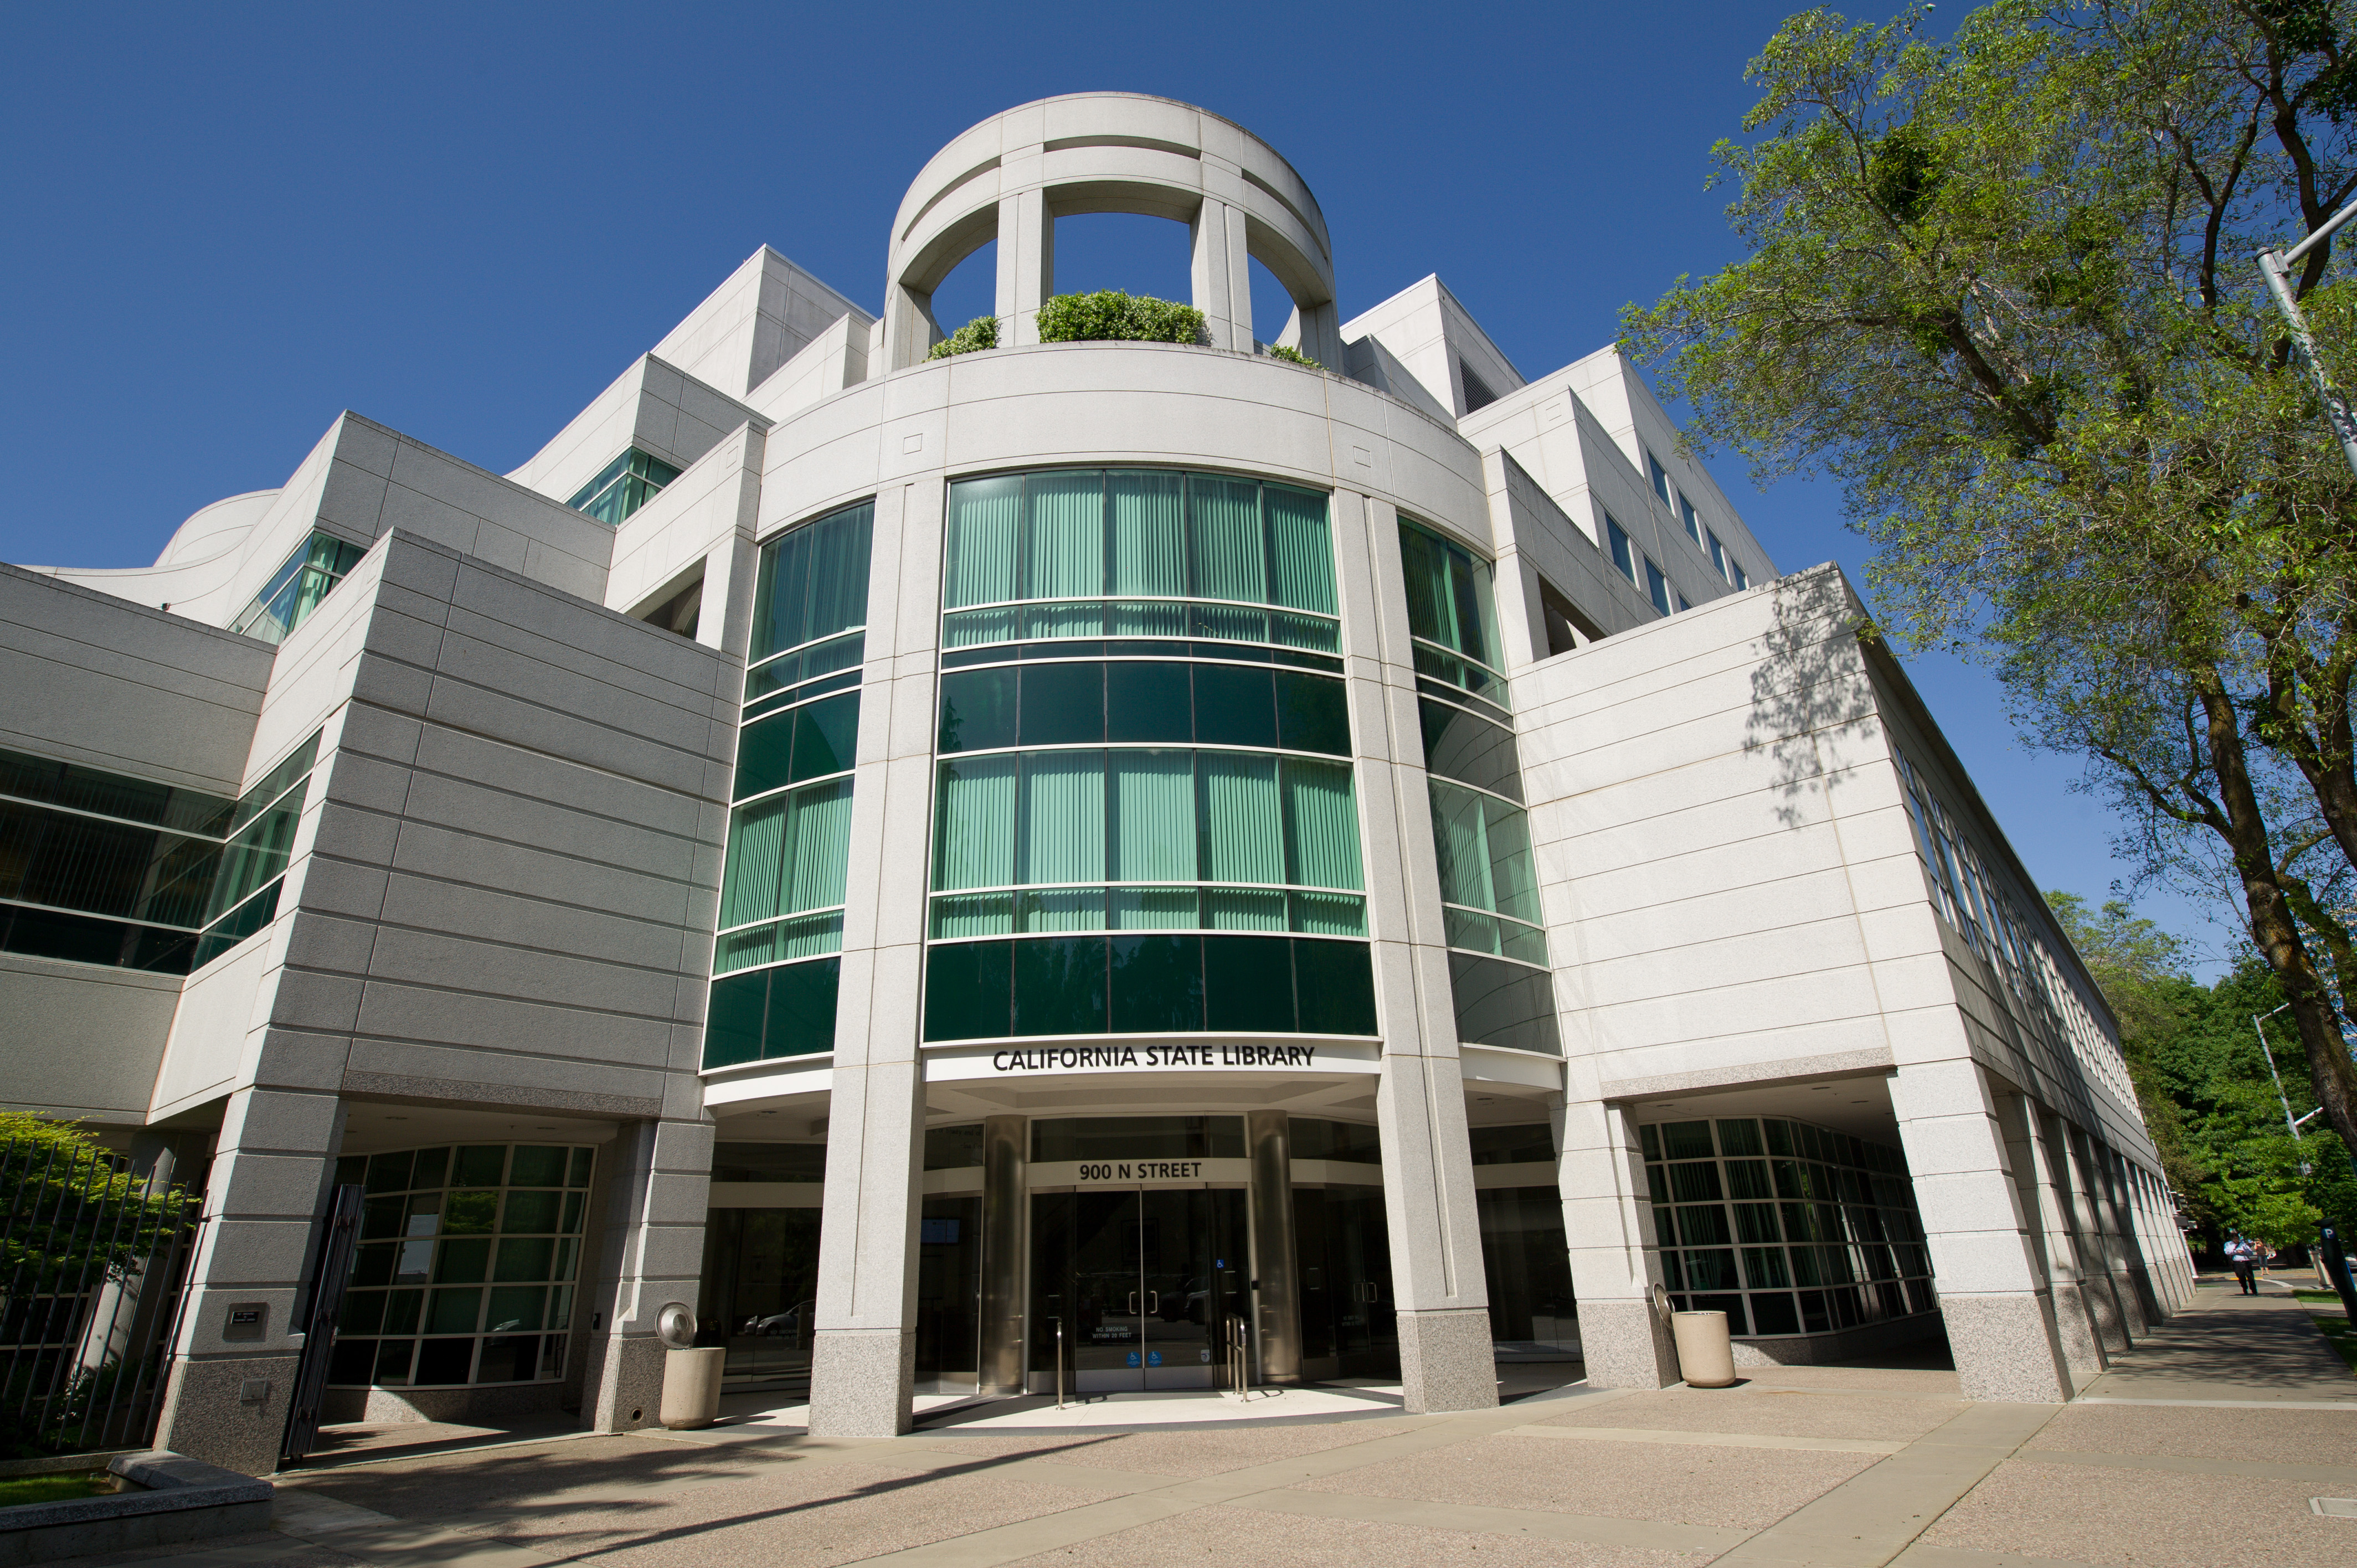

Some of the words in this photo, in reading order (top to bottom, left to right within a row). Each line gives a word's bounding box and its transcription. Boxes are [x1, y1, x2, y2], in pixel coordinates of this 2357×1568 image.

[994, 1046, 1139, 1071] CALIFORNIA
[1146, 1045, 1214, 1066] STATE
[1222, 1045, 1315, 1066] LIBRARY
[1080, 1164, 1111, 1180] 900
[1119, 1164, 1130, 1179] N
[1138, 1163, 1202, 1179] STREET
[2324, 1229, 2333, 1239] P
